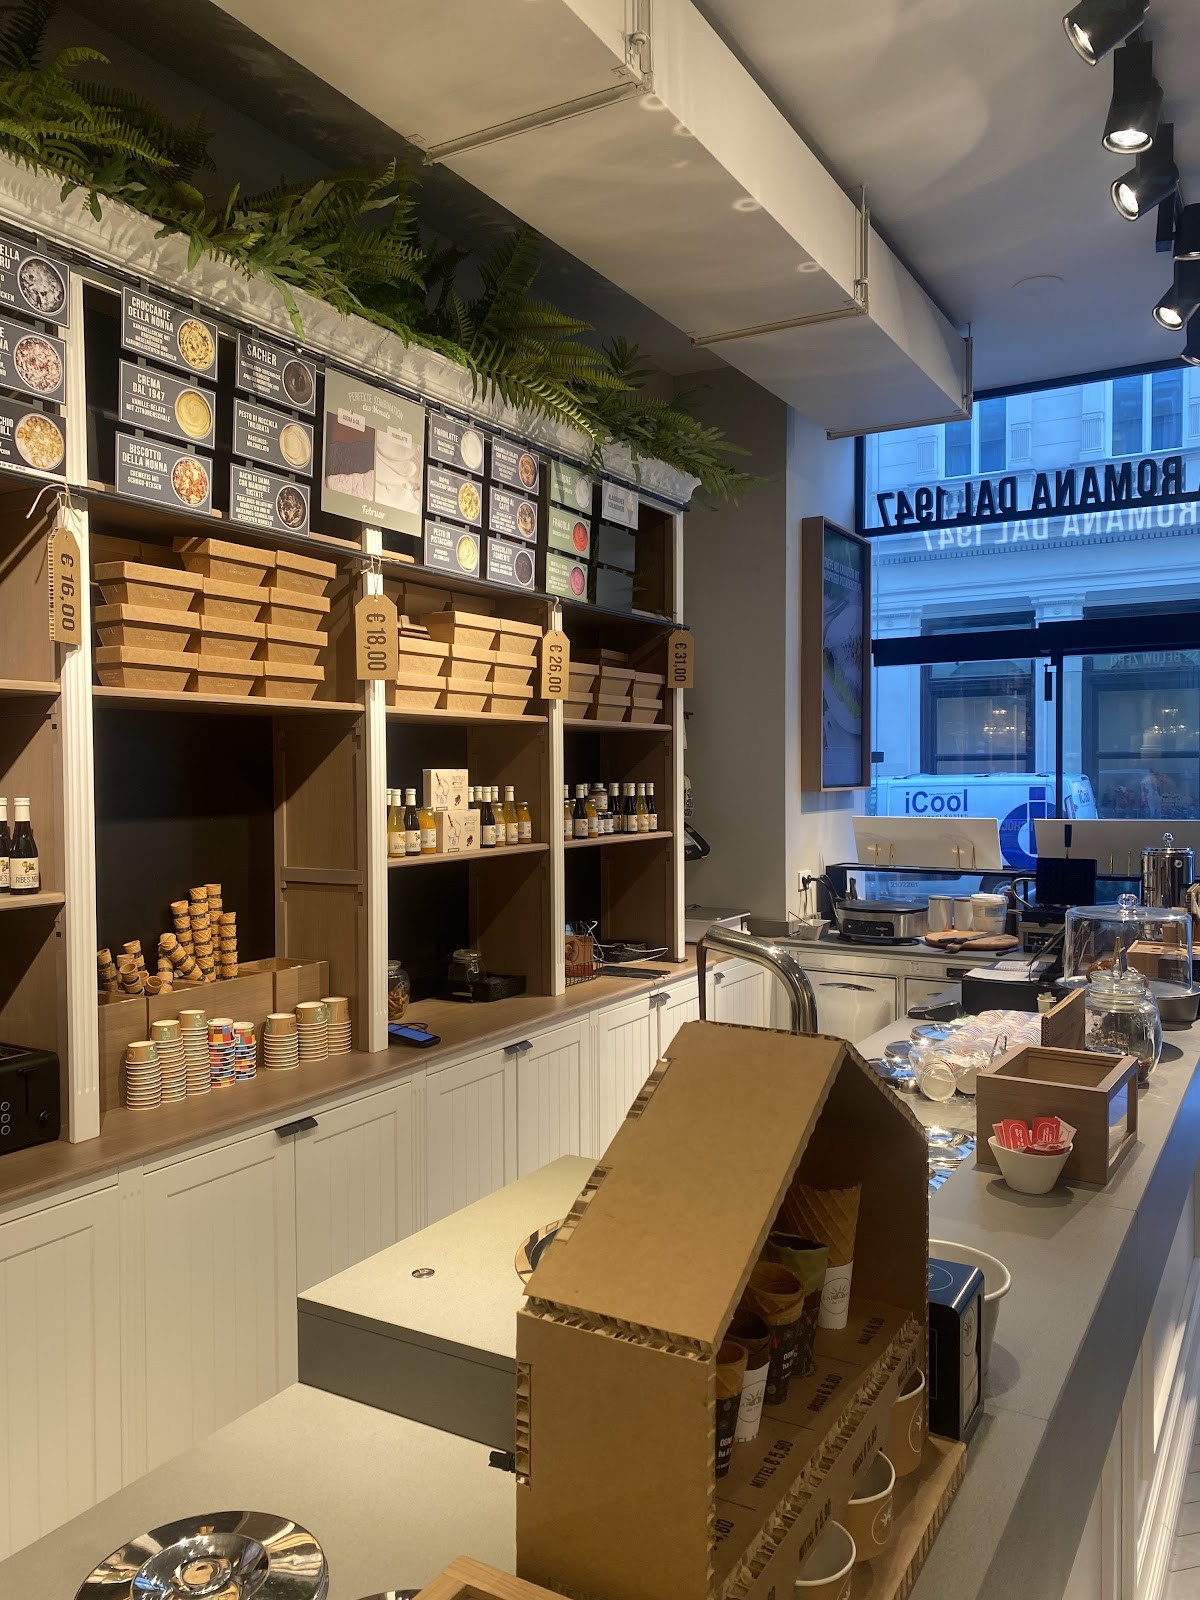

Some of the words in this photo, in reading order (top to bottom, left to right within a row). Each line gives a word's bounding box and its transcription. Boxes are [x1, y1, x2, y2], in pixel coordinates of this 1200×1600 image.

[128, 305, 150, 323] DELLA
[151, 314, 174, 333] NONNA
[131, 296, 171, 321] CROCCANTE
[246, 343, 277, 367] SACHER
[132, 382, 146, 396] DAL
[148, 387, 165, 402] 1947
[137, 373, 161, 391] CREMA
[348, 391, 373, 404] PERFEKTE
[122, 451, 144, 467] DELLA
[145, 458, 168, 474] NONNA
[129, 443, 162, 461] BISCOTTO
[361, 504, 386, 520] Februar
[60, 552, 75, 568] €
[59, 573, 76, 632] 16,00
[365, 612, 387, 623] €
[363, 627, 387, 671] 18,00
[549, 643, 563, 654] €
[674, 642, 688, 651] €
[546, 654, 563, 693] 26,00
[673, 652, 687, 683] 31,00
[905, 788, 968, 814] iCool
[749, 1465, 777, 1489] MITTEL
